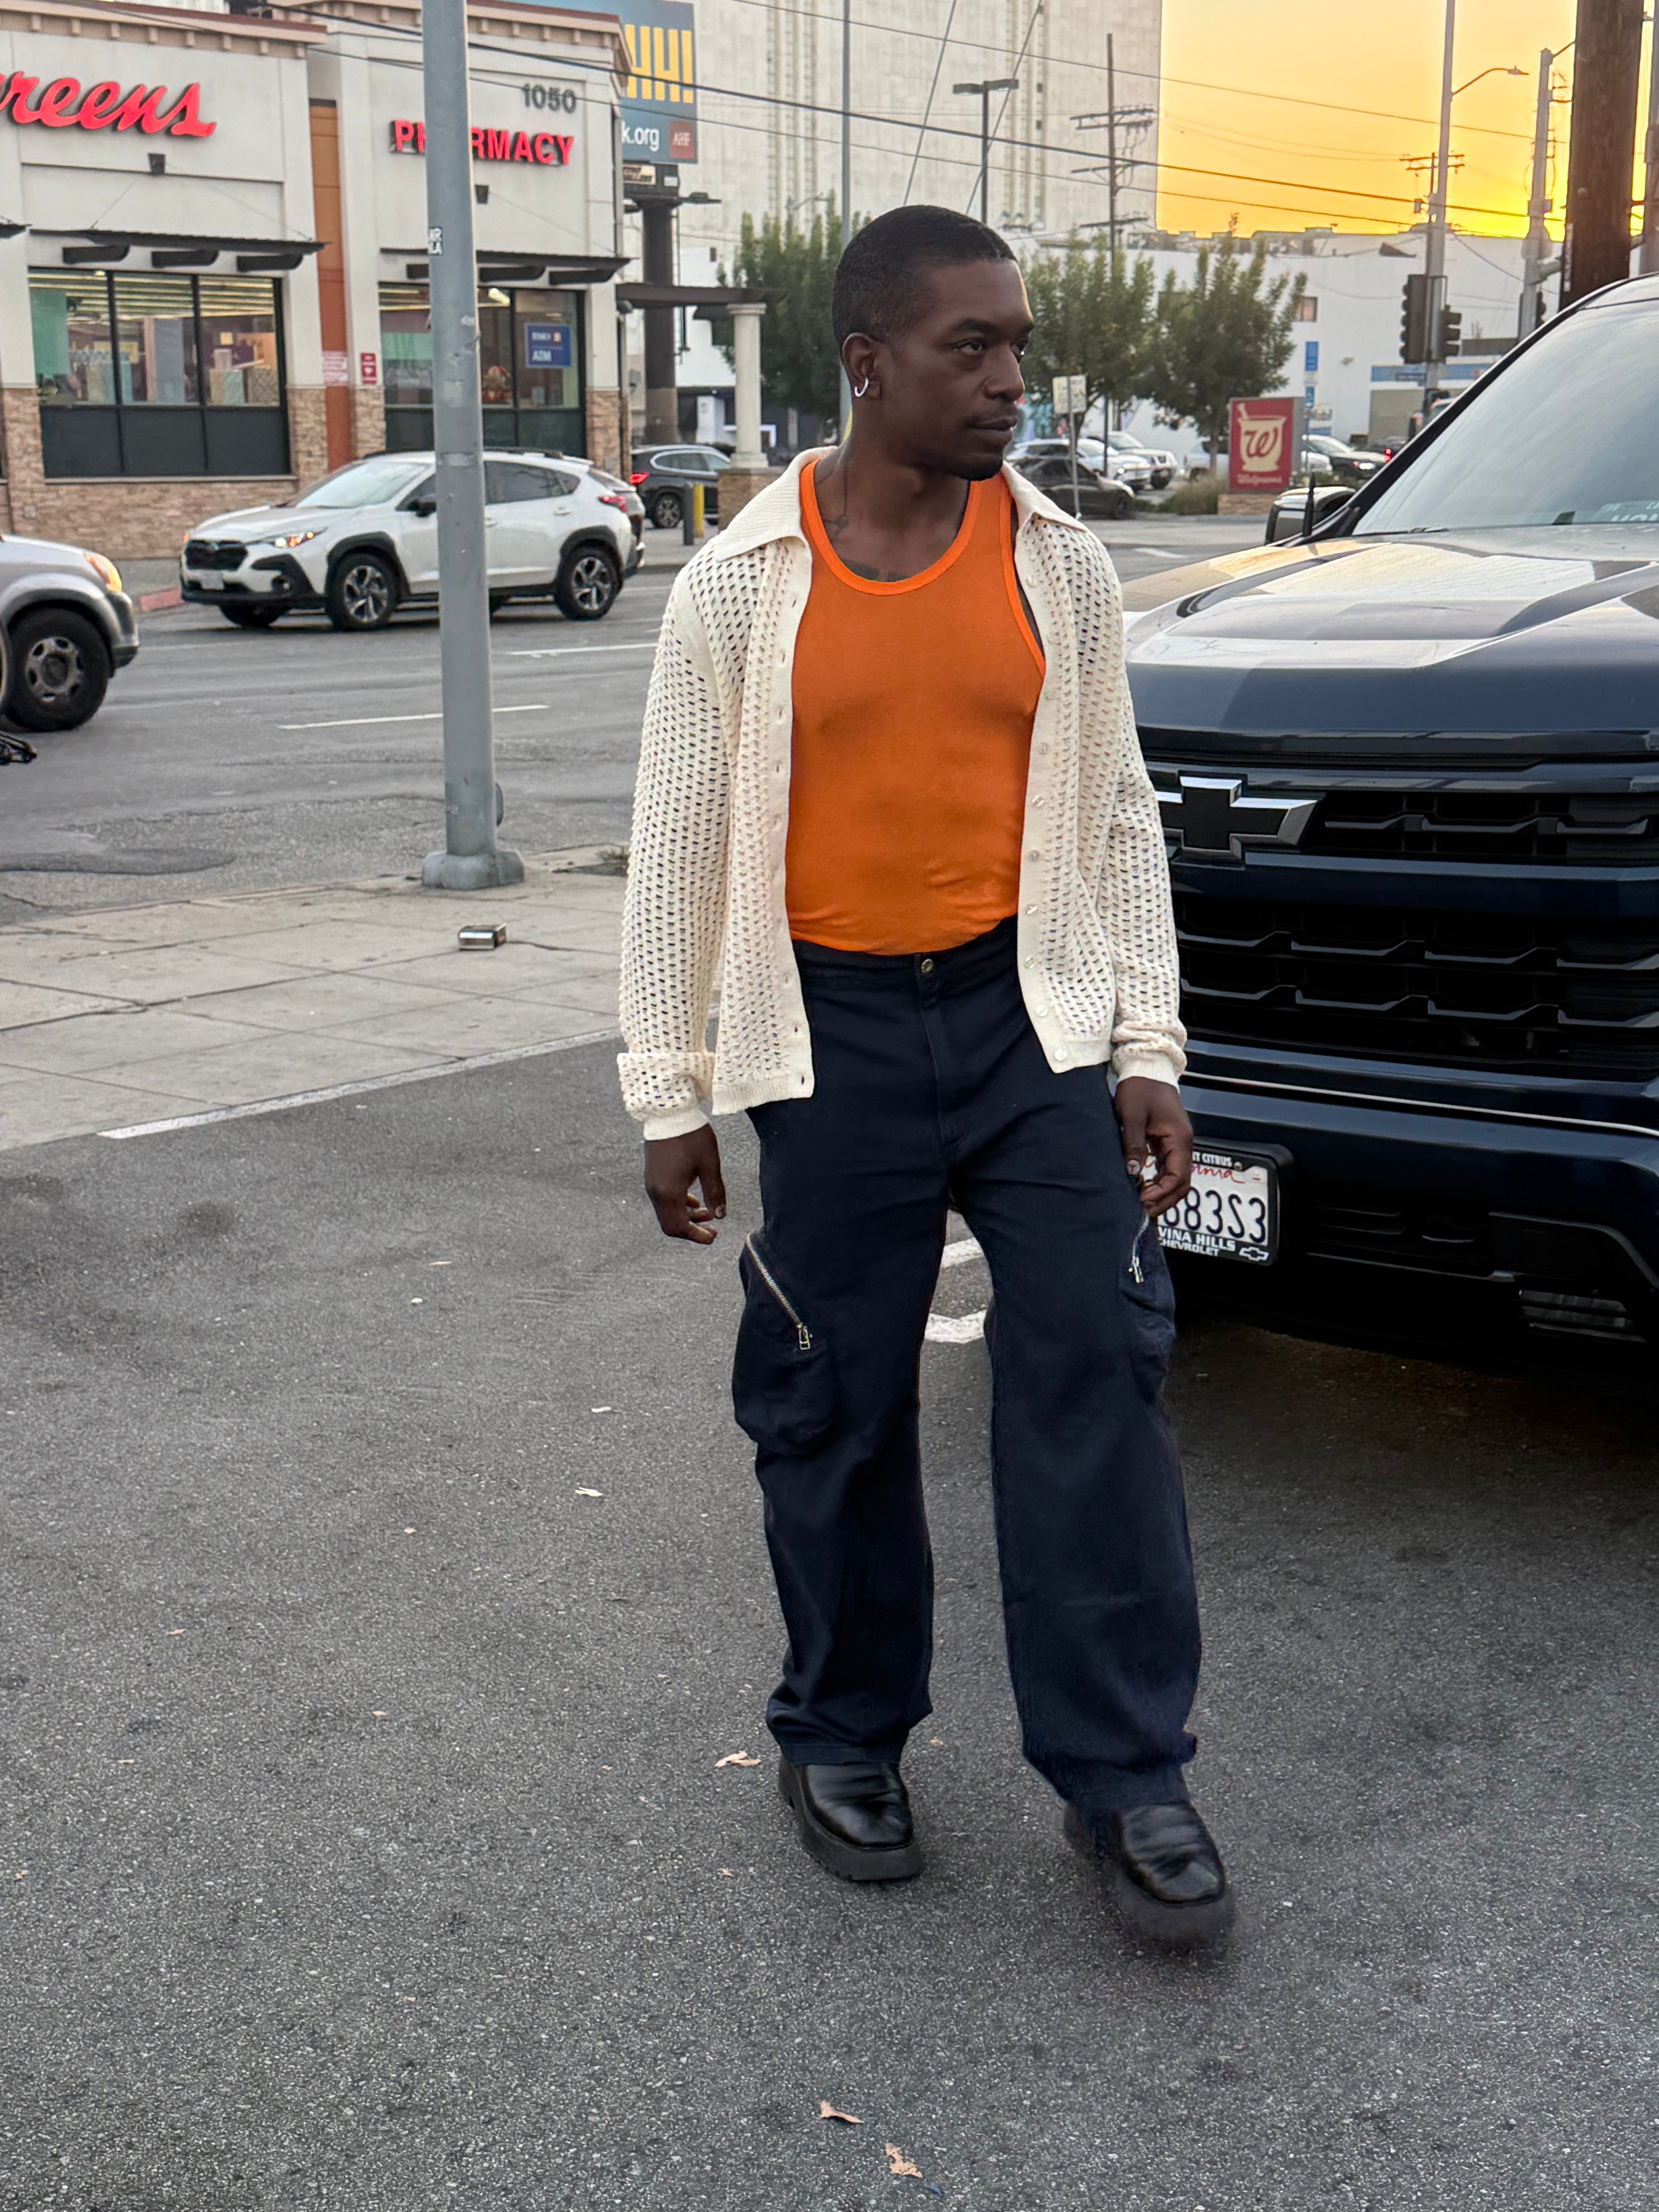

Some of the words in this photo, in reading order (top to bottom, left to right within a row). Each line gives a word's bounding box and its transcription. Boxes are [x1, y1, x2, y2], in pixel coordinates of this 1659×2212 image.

[0, 71, 216, 138] reens
[522, 83, 576, 114] 1050
[394, 120, 574, 166] PRMACY
[1202, 1153, 1232, 1167] CITRUS
[1195, 1233, 1236, 1252] HILLS
